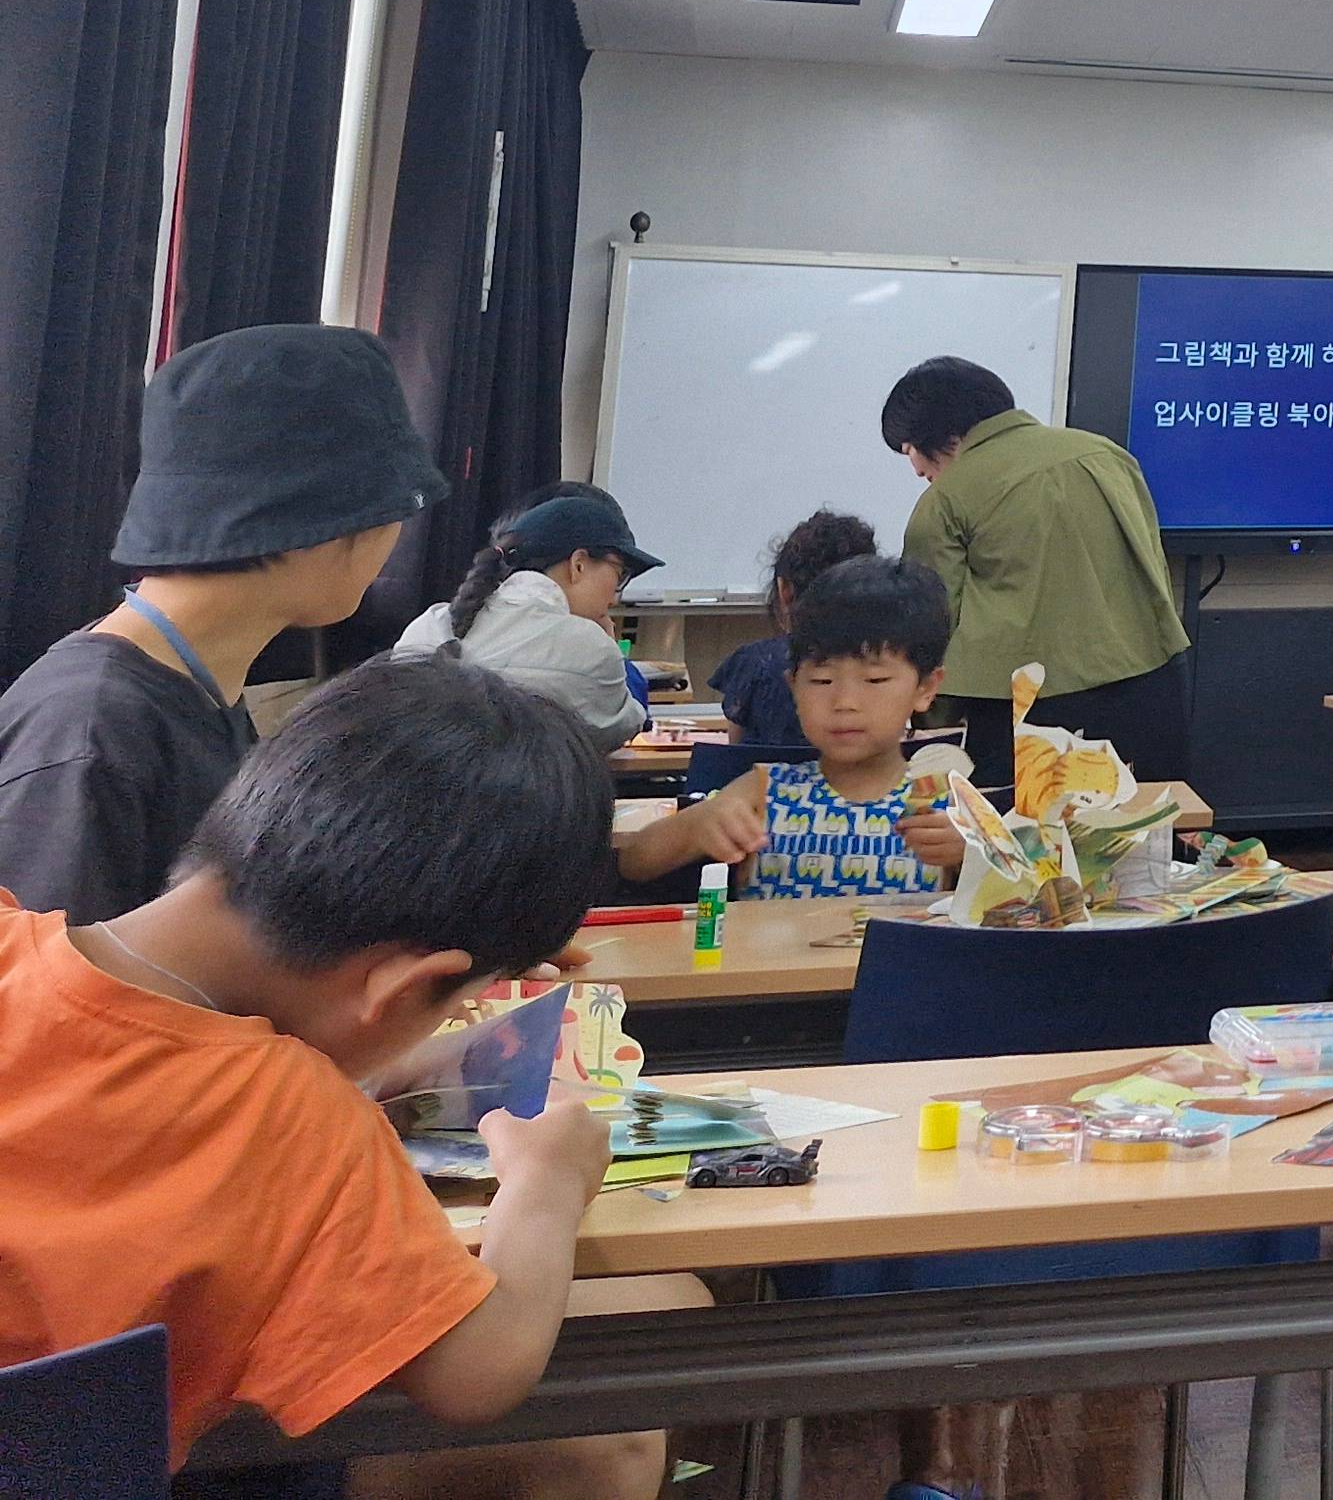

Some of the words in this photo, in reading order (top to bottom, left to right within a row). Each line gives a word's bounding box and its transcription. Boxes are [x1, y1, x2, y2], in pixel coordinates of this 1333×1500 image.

[1155, 341, 1258, 369] 그림책과
[1265, 342, 1314, 369] 함께
[1154, 401, 1279, 428] 업사이클링
